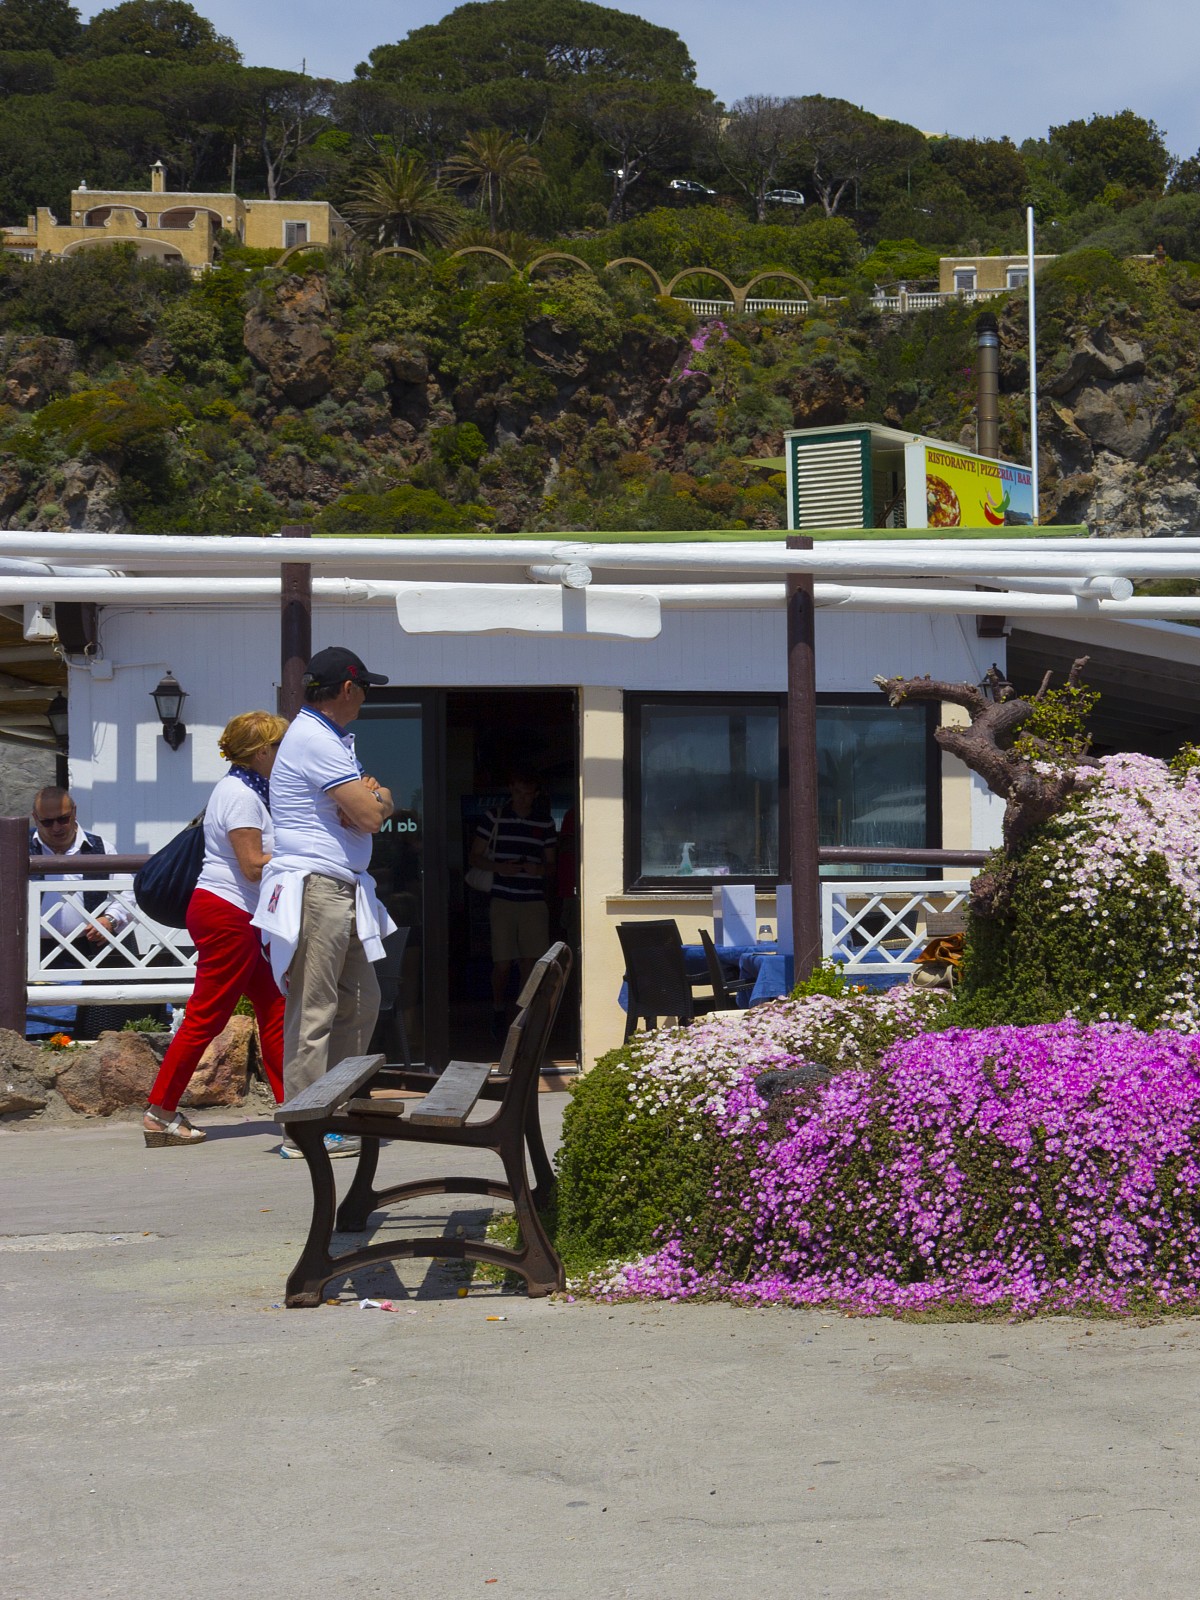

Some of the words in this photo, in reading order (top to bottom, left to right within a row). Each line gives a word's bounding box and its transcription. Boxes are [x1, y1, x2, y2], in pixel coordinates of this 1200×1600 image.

[928, 451, 976, 473] RISTORANTE
[980, 464, 1013, 481] PIZZERIA
[1017, 472, 1031, 485] BAR
